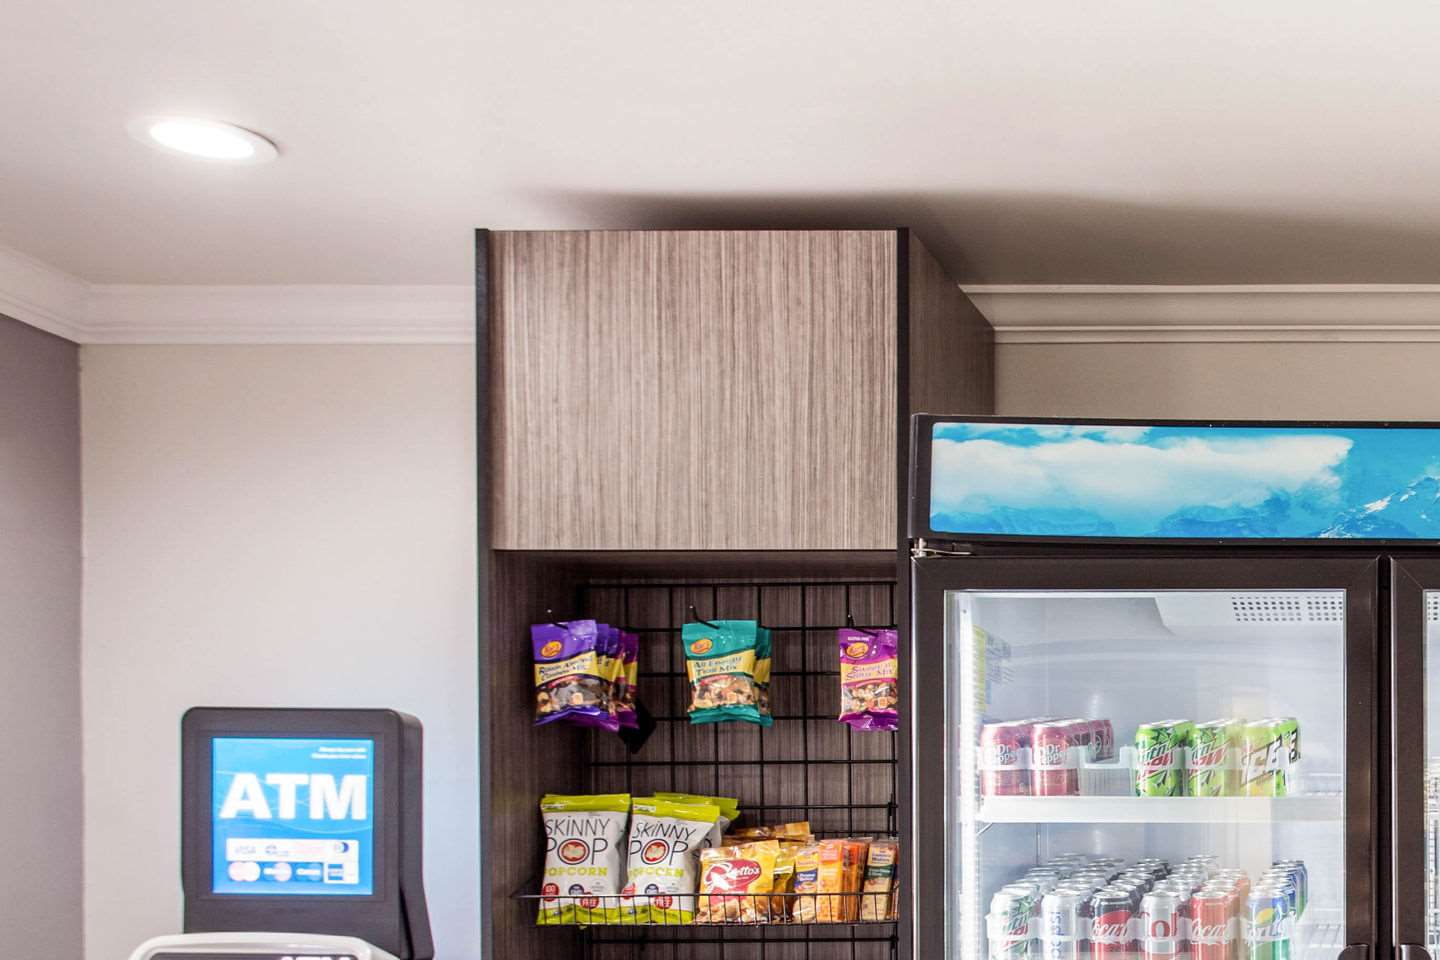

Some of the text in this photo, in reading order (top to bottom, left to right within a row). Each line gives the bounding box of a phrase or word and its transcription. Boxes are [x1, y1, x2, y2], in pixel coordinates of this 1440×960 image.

[218, 772, 368, 820] ATM
[545, 815, 611, 837] SKINNY
[632, 821, 697, 841] SKINNY
[546, 837, 609, 865] POP
[629, 838, 689, 866] POP
